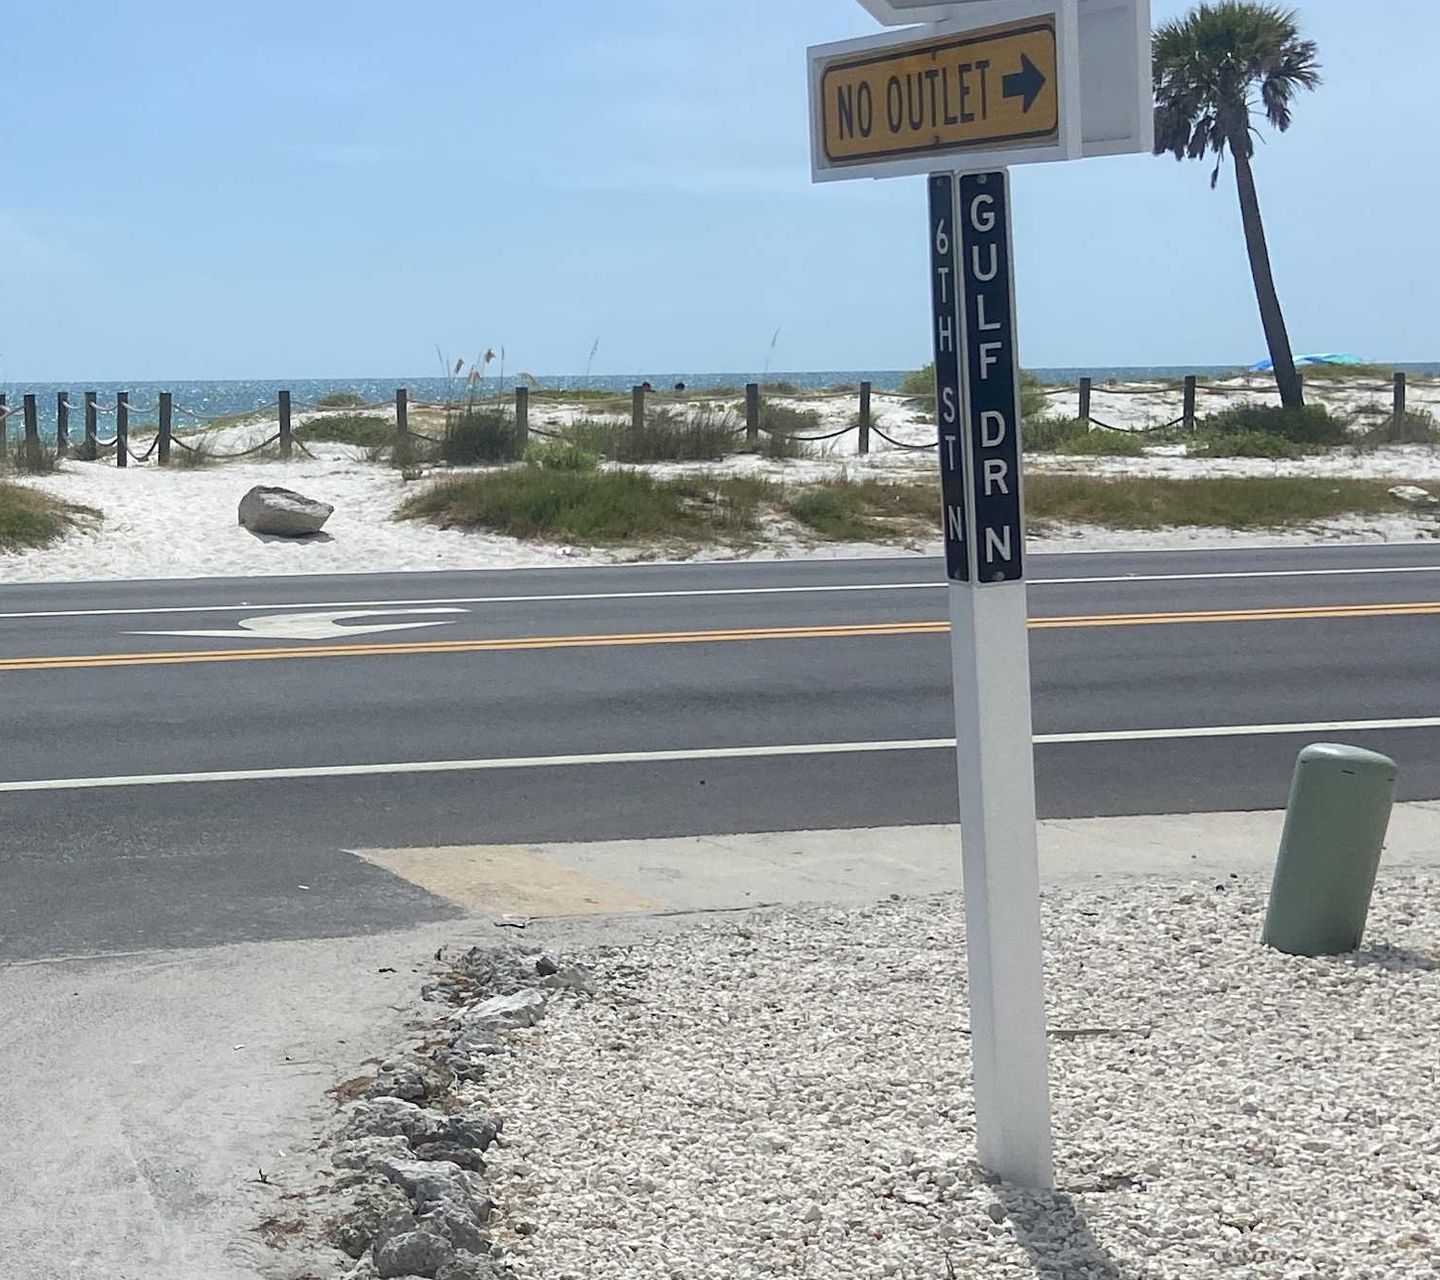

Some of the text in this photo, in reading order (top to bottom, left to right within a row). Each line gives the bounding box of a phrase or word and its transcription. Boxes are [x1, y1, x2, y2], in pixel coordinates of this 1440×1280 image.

[836, 59, 990, 140] NO OUTLET
[935, 218, 963, 543] 6TH ST N
[970, 194, 1012, 563] GULF DR N
